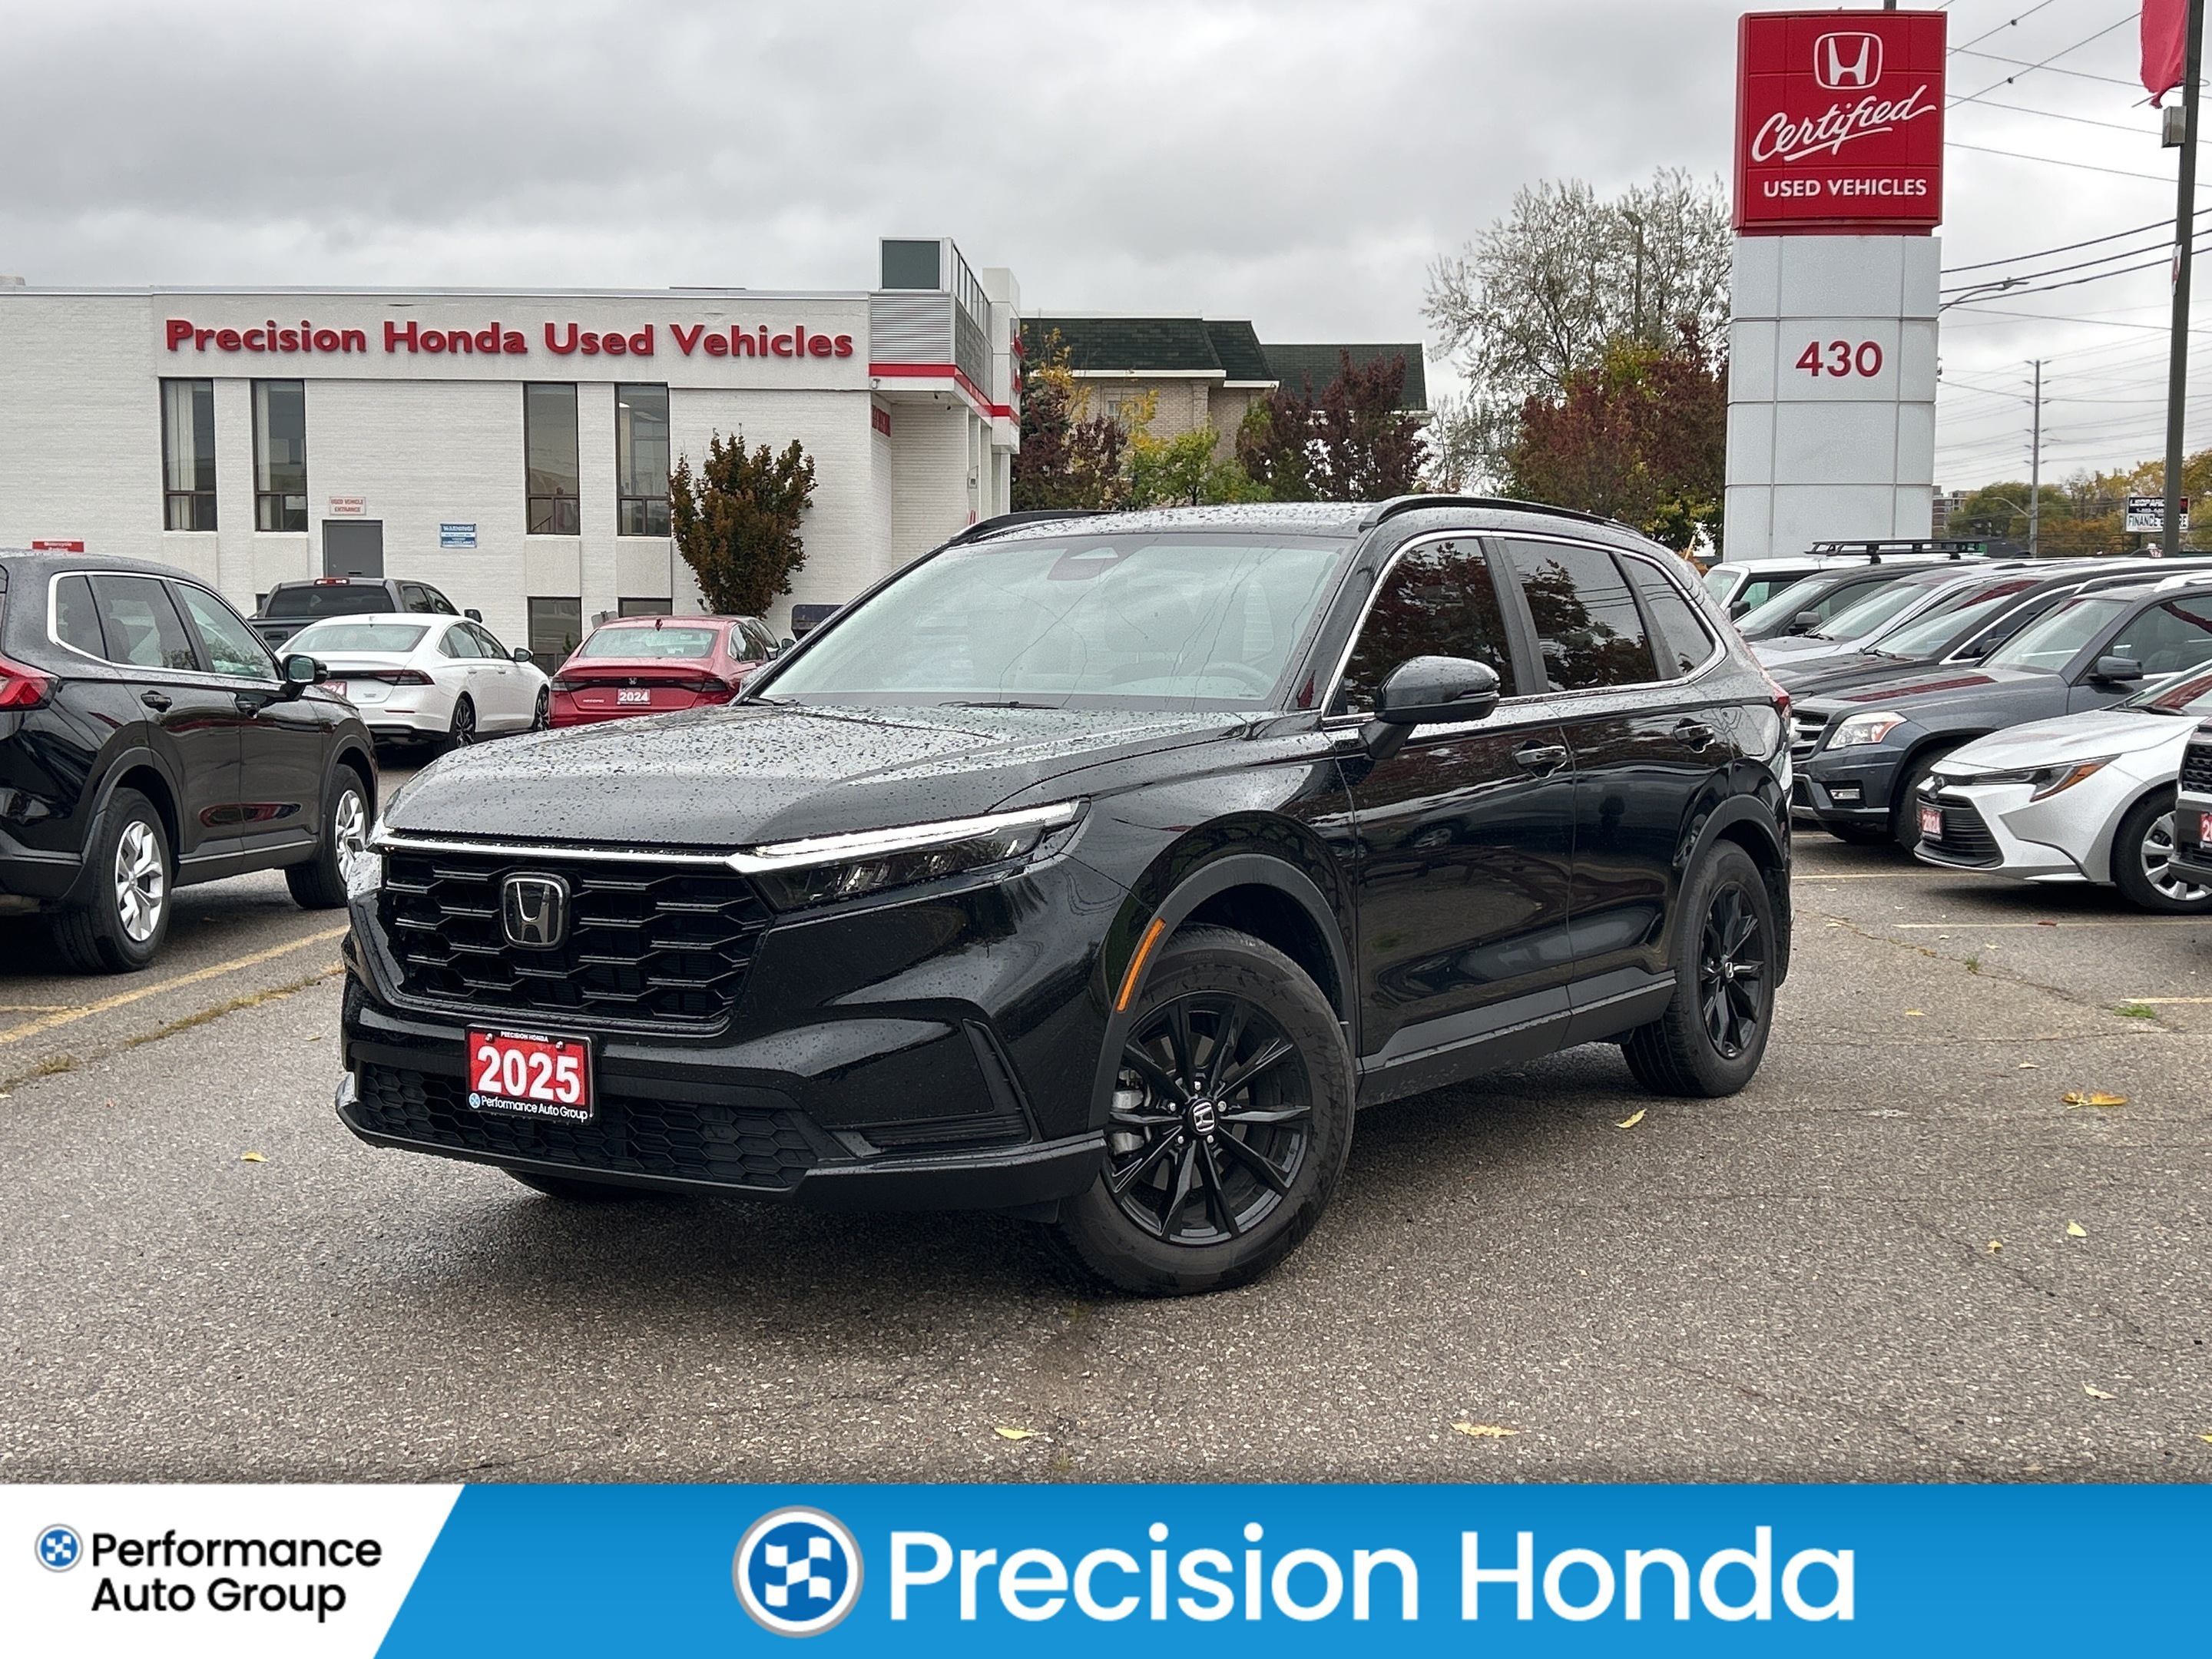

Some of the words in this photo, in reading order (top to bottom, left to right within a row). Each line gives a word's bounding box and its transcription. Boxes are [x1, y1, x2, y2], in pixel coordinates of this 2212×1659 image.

[1752, 84, 1937, 162] Certified
[1763, 180, 1821, 197] USED
[1827, 178, 1927, 196] VEHICLES
[167, 320, 366, 353] Precision
[384, 321, 528, 354] Honda
[545, 323, 654, 356] Used
[669, 324, 853, 357] Vehicles
[1796, 340, 1883, 377] 430
[619, 691, 648, 702] 2024
[500, 1030, 528, 1041] PRECISION
[477, 1045, 580, 1103] 2025
[481, 1096, 538, 1113] Performance
[538, 1104, 558, 1116] Auto
[560, 1107, 588, 1123] Group
